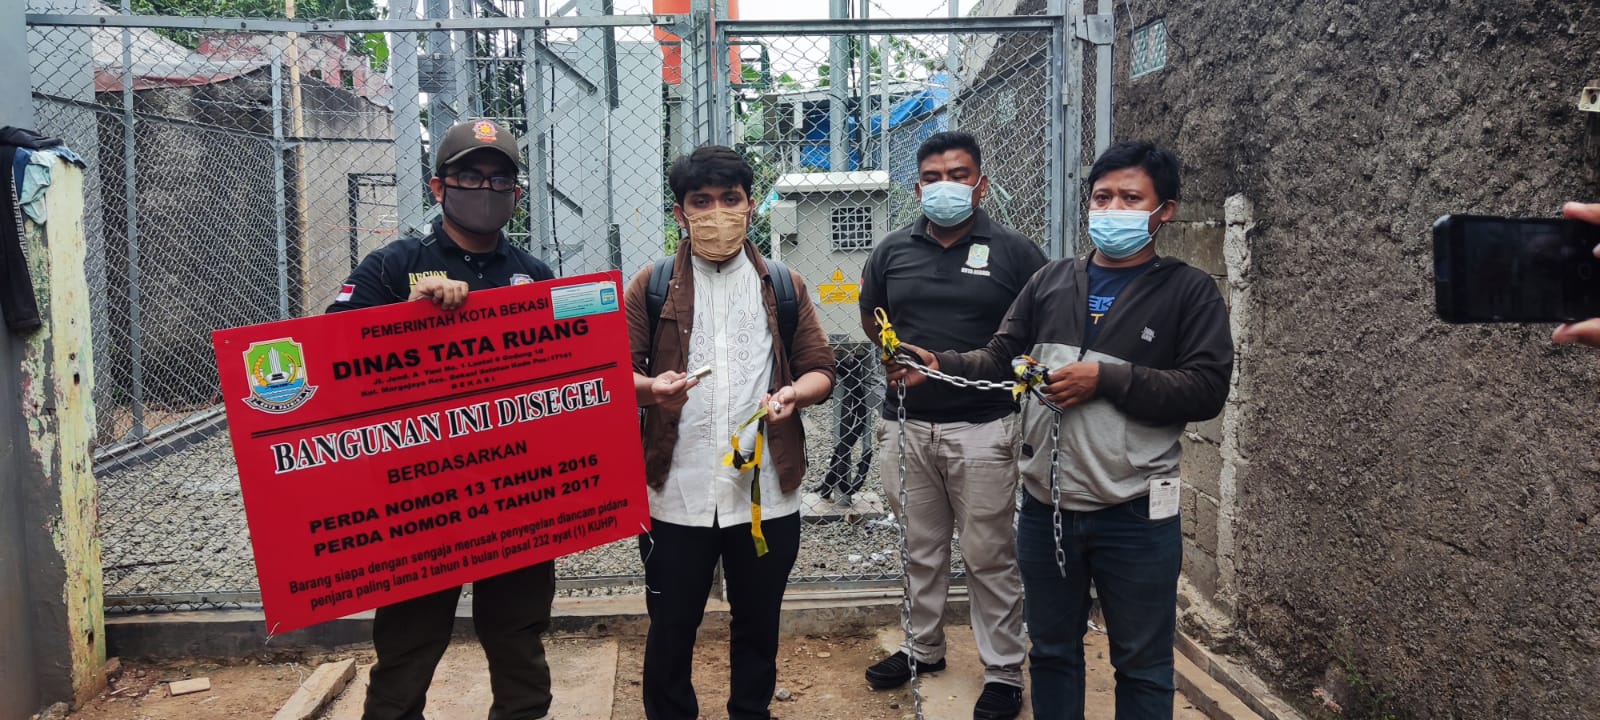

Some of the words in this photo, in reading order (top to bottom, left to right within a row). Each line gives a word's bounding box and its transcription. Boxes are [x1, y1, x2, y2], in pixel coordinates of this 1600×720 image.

[332, 348, 421, 380] DINAS
[428, 336, 495, 362] TATA
[502, 318, 589, 349] RUANG
[361, 315, 456, 339] PEMERINTAH
[460, 307, 496, 323] KOTA
[499, 297, 549, 316] BEKASI
[271, 412, 442, 474] BANGUNAN
[445, 402, 493, 438] INI
[495, 377, 611, 427] DISEGEL
[387, 440, 527, 484] BERDASARKAN
[310, 508, 379, 534] PERDA
[385, 489, 458, 517] NOMOR
[464, 482, 486, 497] 13
[491, 465, 553, 491] TAHUN
[557, 454, 598, 475] 2016
[314, 530, 383, 557] PERDA
[389, 510, 462, 539] NOMOR
[467, 503, 489, 519] 04
[494, 486, 556, 512] TAHUN
[561, 475, 600, 495] 2017
[289, 574, 332, 594] Barang
[335, 566, 365, 583] siapa
[368, 556, 408, 574] dengan
[411, 544, 452, 563] sengaja
[455, 530, 498, 552] merusak
[501, 518, 556, 543] penyegelan
[557, 507, 595, 524] diancam
[598, 499, 628, 517] pidana
[310, 588, 353, 611] penjara
[356, 578, 391, 599] paling
[394, 571, 419, 586] lama
[421, 566, 428, 579] 2
[430, 558, 460, 576] tahun
[462, 556, 469, 567] 8
[472, 548, 499, 566] bulan
[501, 540, 531, 560] (pasal
[533, 534, 549, 549] 232
[552, 528, 572, 545] ayat
[574, 524, 587, 540] (1)
[587, 515, 618, 533] KUHP)
